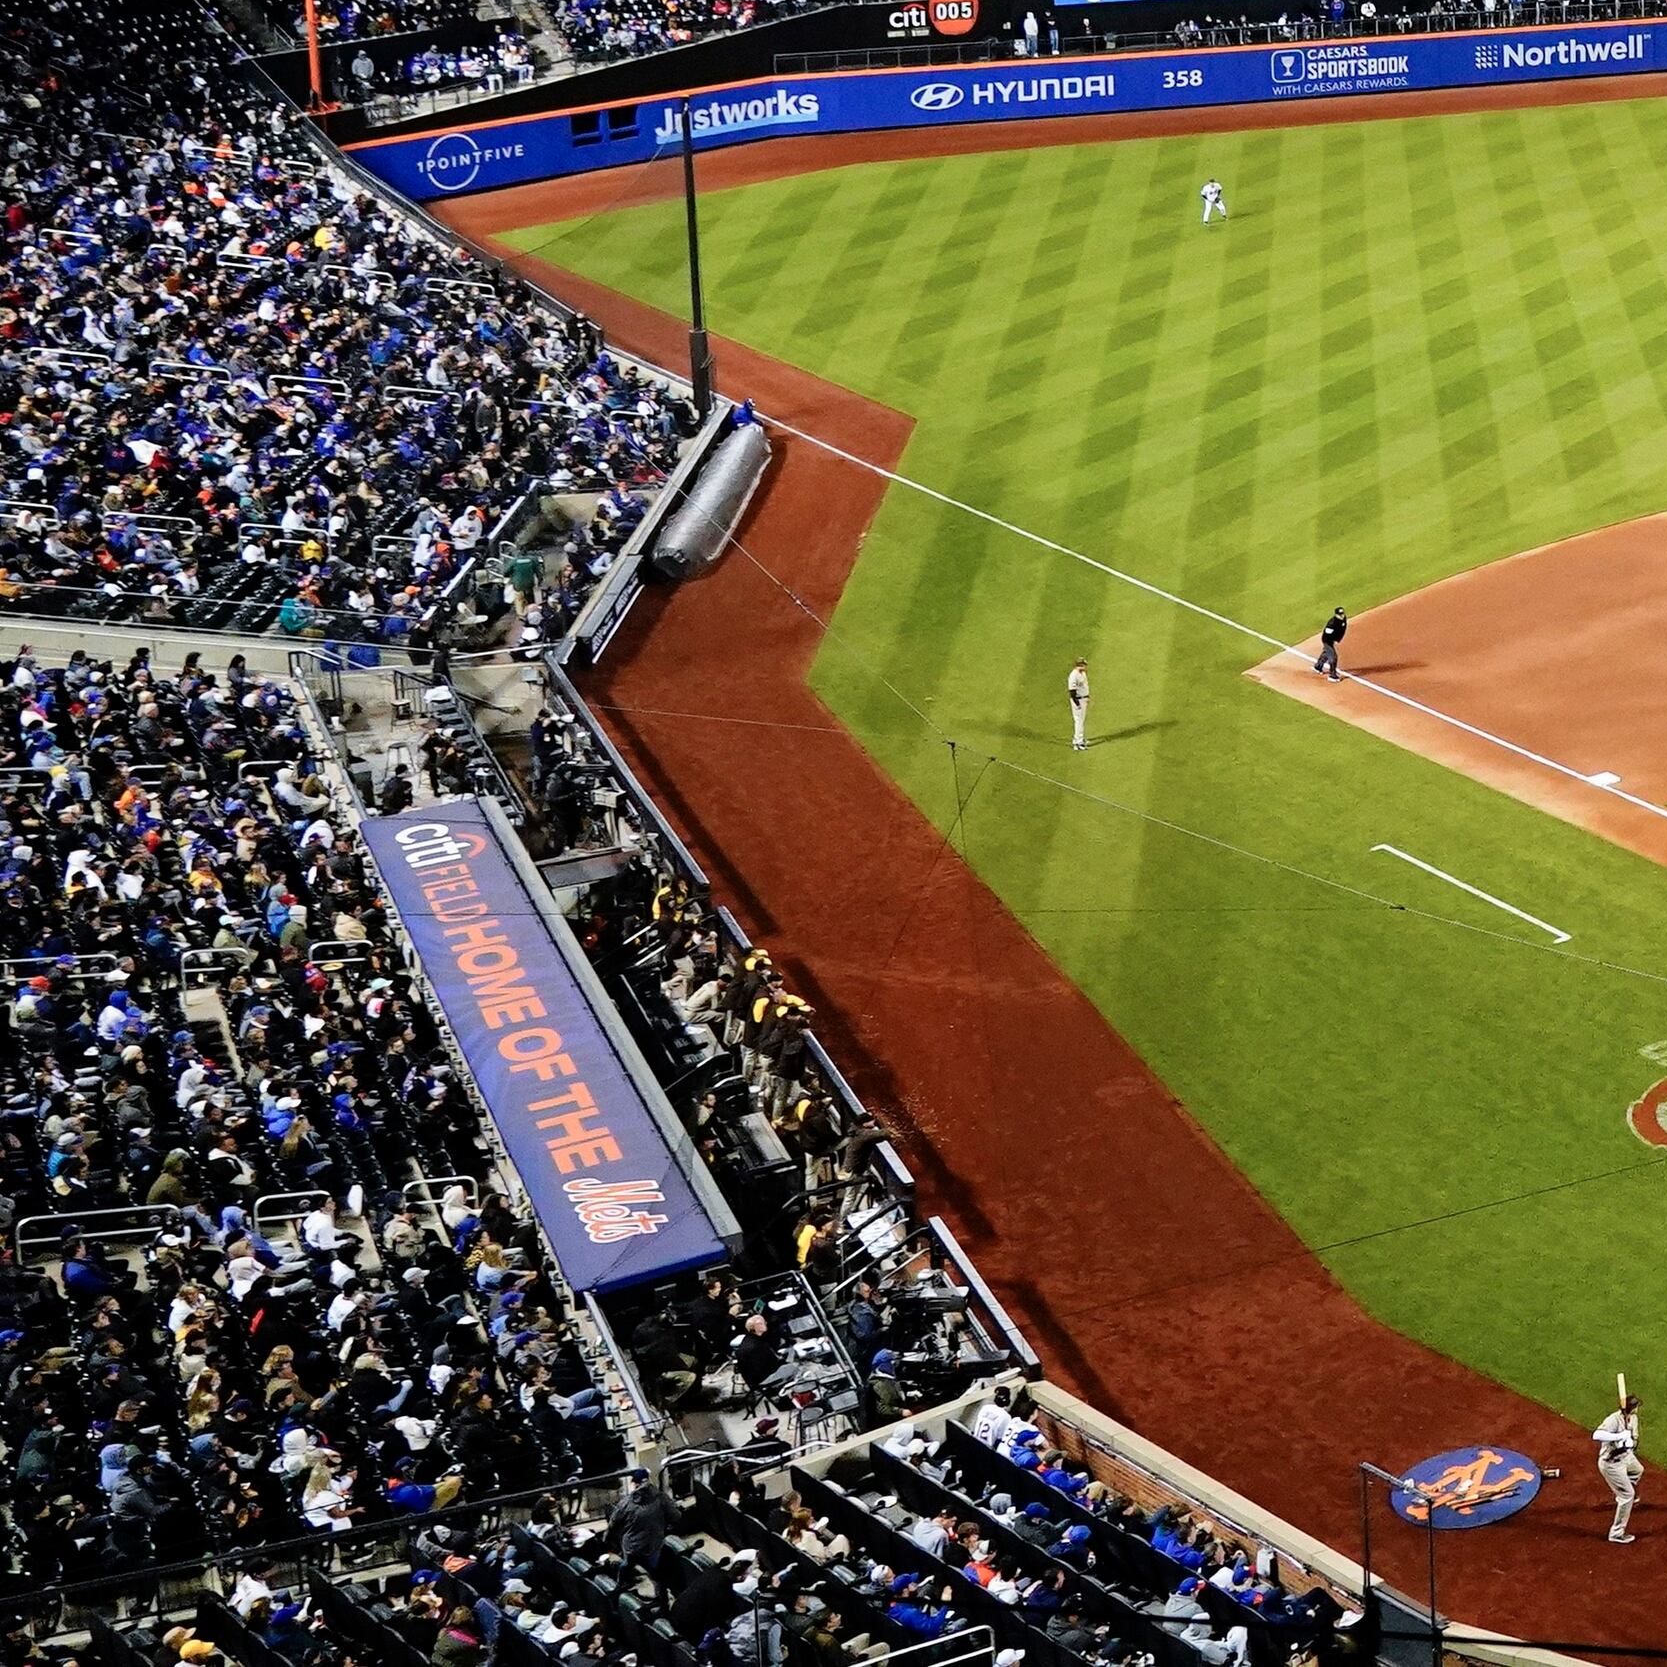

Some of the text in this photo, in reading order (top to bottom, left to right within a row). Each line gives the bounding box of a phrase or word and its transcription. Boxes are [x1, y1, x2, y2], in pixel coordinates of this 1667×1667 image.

[889, 2, 972, 28] citi 005
[1308, 46, 1367, 60] CAESARS
[1503, 35, 1644, 68] Northwell
[1163, 69, 1203, 89] 358
[1308, 56, 1409, 79] SPORTSBOOK
[974, 75, 1114, 105] HYUNDAI
[1272, 77, 1408, 95] WITH CAESARS REWARDS
[417, 144, 524, 172] 1POINTFIVE
[395, 823, 670, 1244] citi FIELD HOME OF THE Mets
